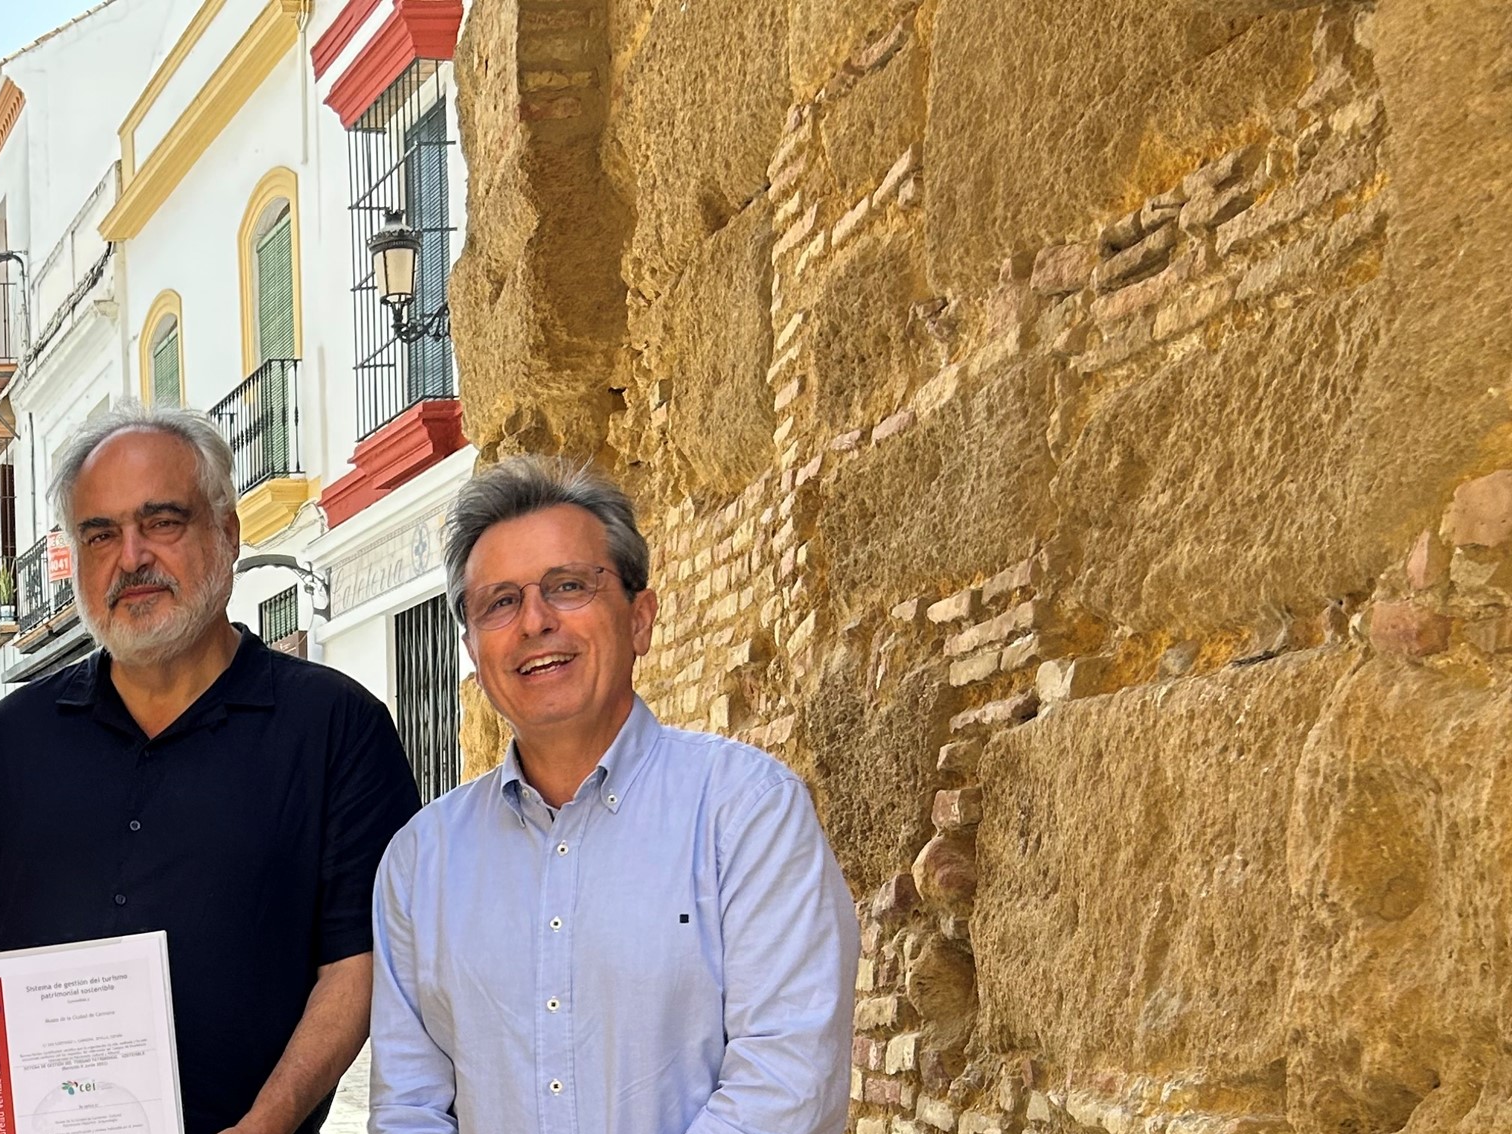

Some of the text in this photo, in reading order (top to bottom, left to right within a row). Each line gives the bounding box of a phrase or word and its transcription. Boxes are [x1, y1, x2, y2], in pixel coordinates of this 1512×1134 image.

[26, 984, 52, 993] Sistema
[63, 979, 88, 989] gestión
[101, 974, 128, 983] turismo
[40, 984, 115, 1000] patrimonial sostenible
[79, 1080, 96, 1092] cei
